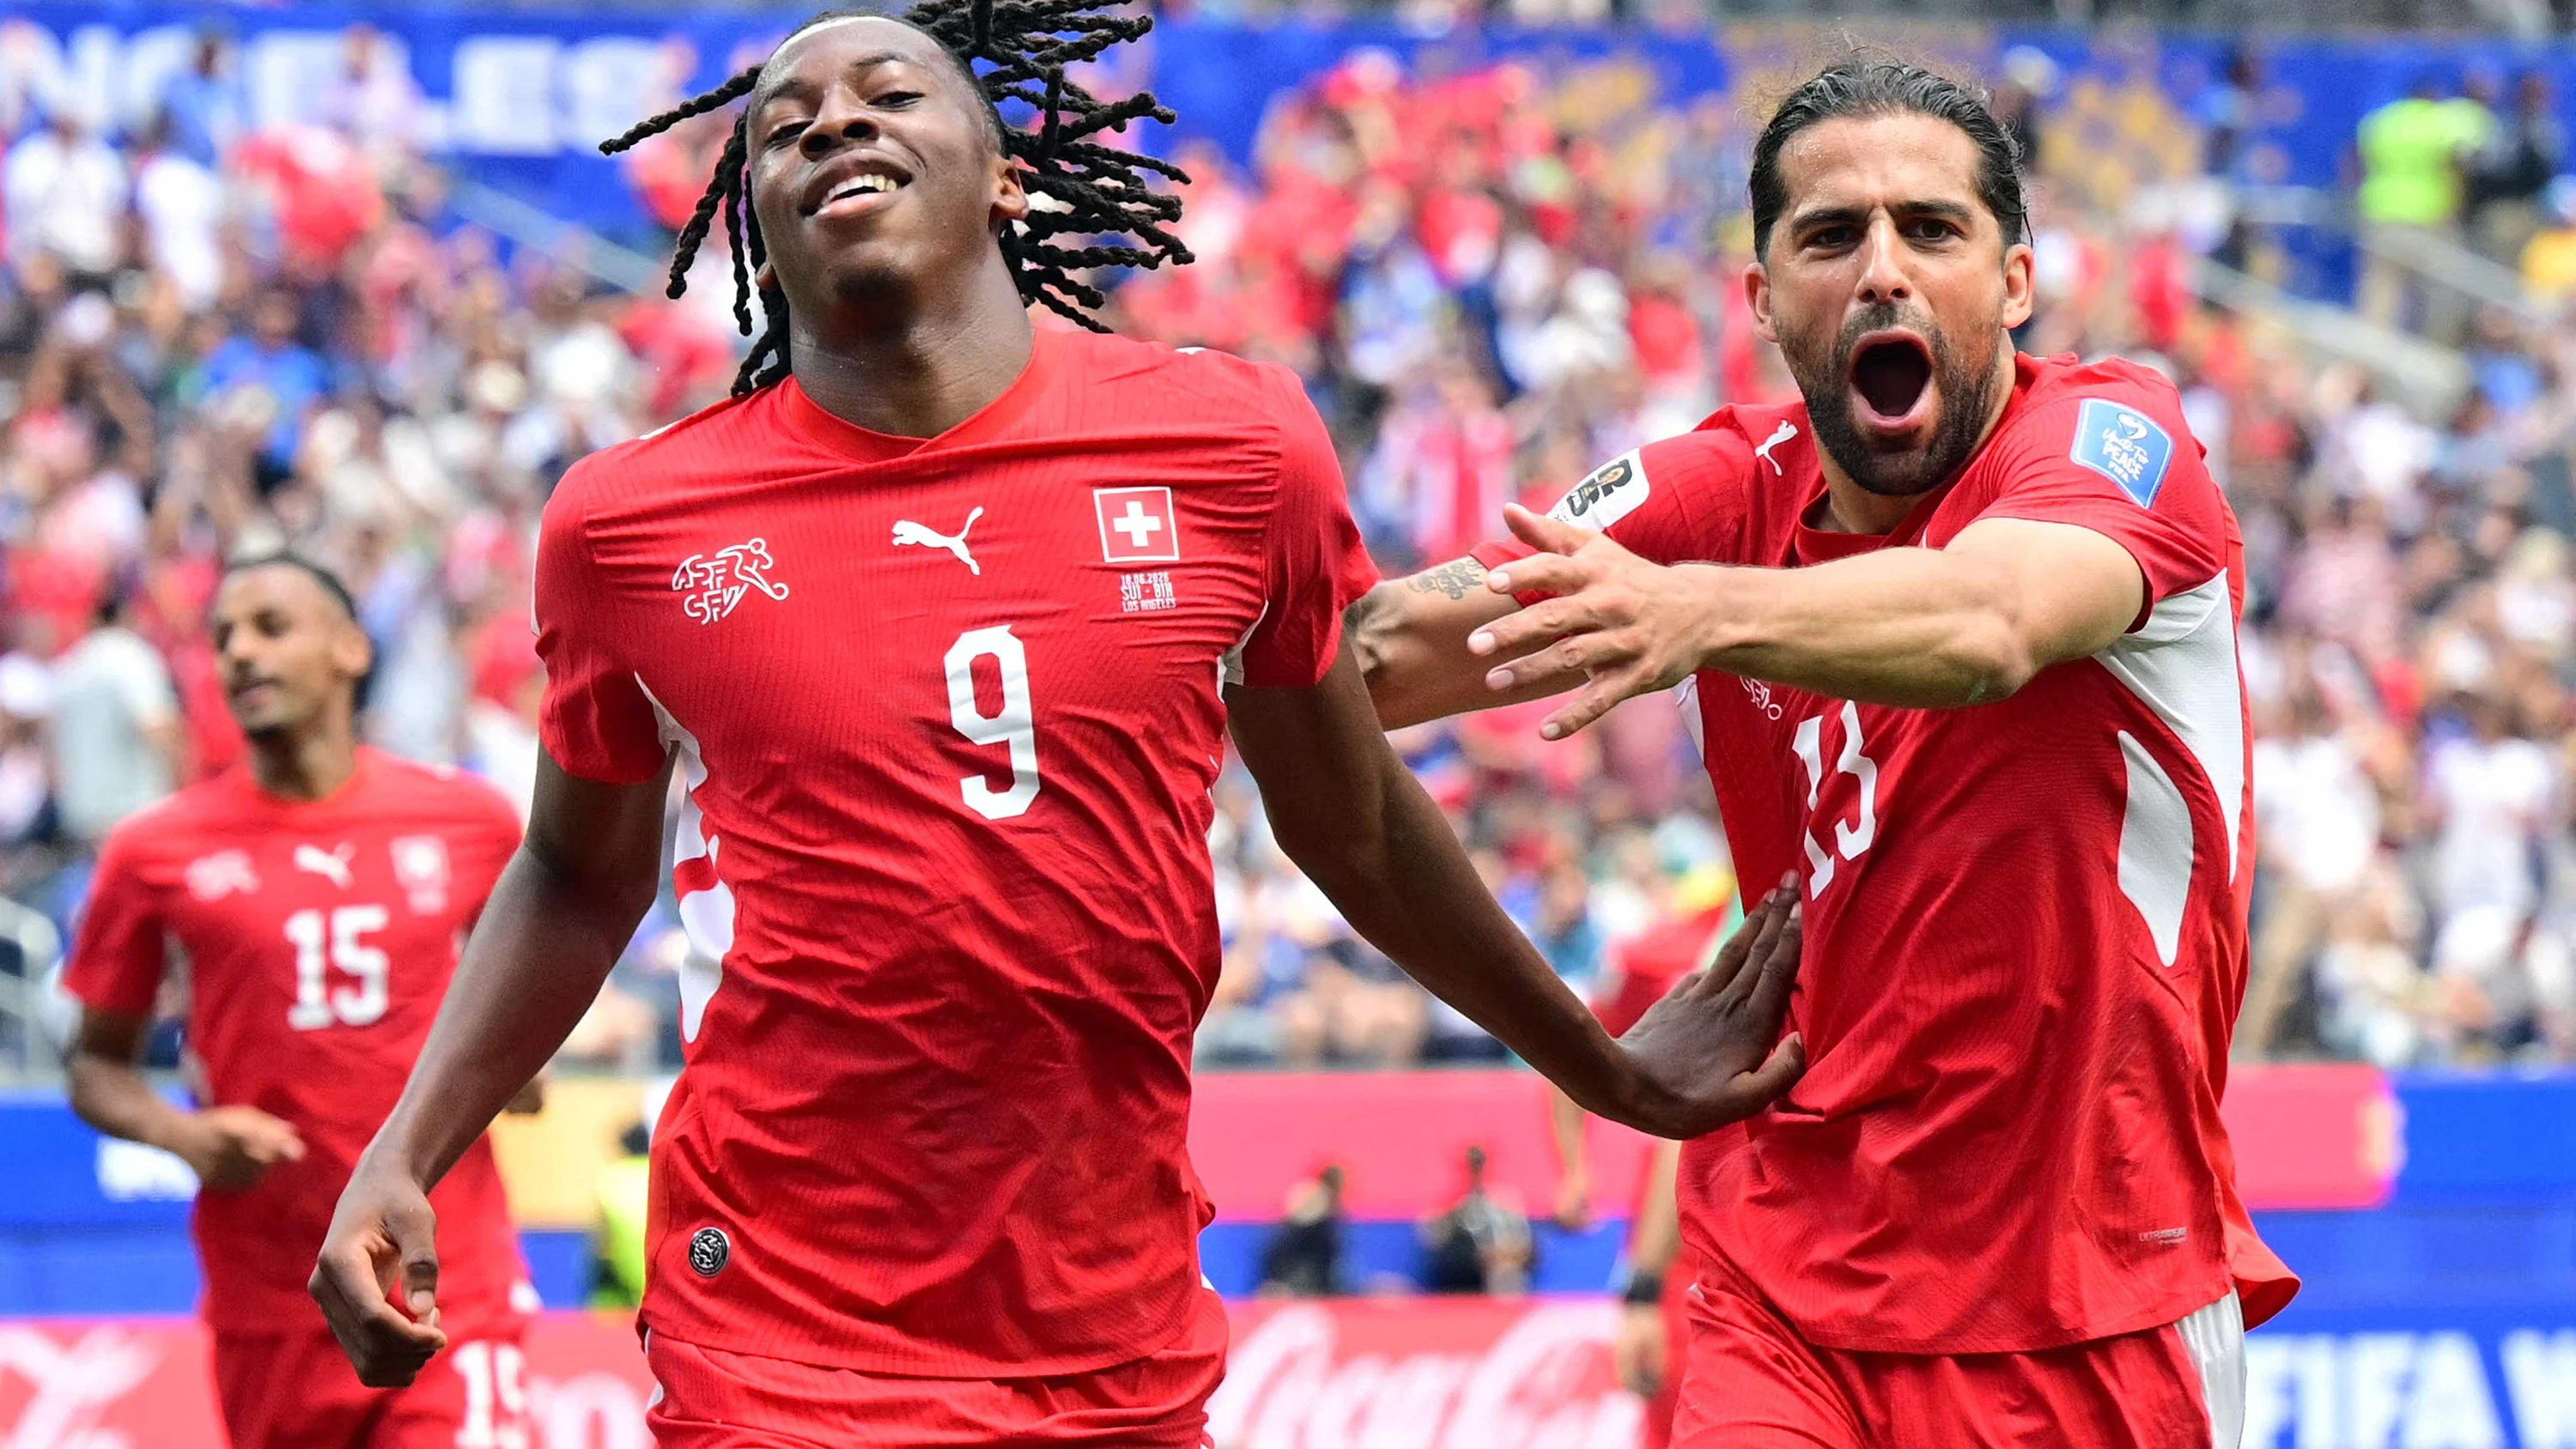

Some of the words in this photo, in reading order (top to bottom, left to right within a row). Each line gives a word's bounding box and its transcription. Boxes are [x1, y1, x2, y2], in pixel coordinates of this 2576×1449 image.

[2102, 440, 2144, 481] PEACE
[1121, 584, 1142, 601] SUI
[1153, 581, 1174, 598] BIH
[1121, 600, 1139, 613] LOS
[1140, 597, 1177, 611] ANGELES
[943, 623, 1041, 821] 9
[1791, 699, 1878, 901] 13
[283, 904, 390, 1031] 15
[2245, 1331, 2514, 1449] FIFA
